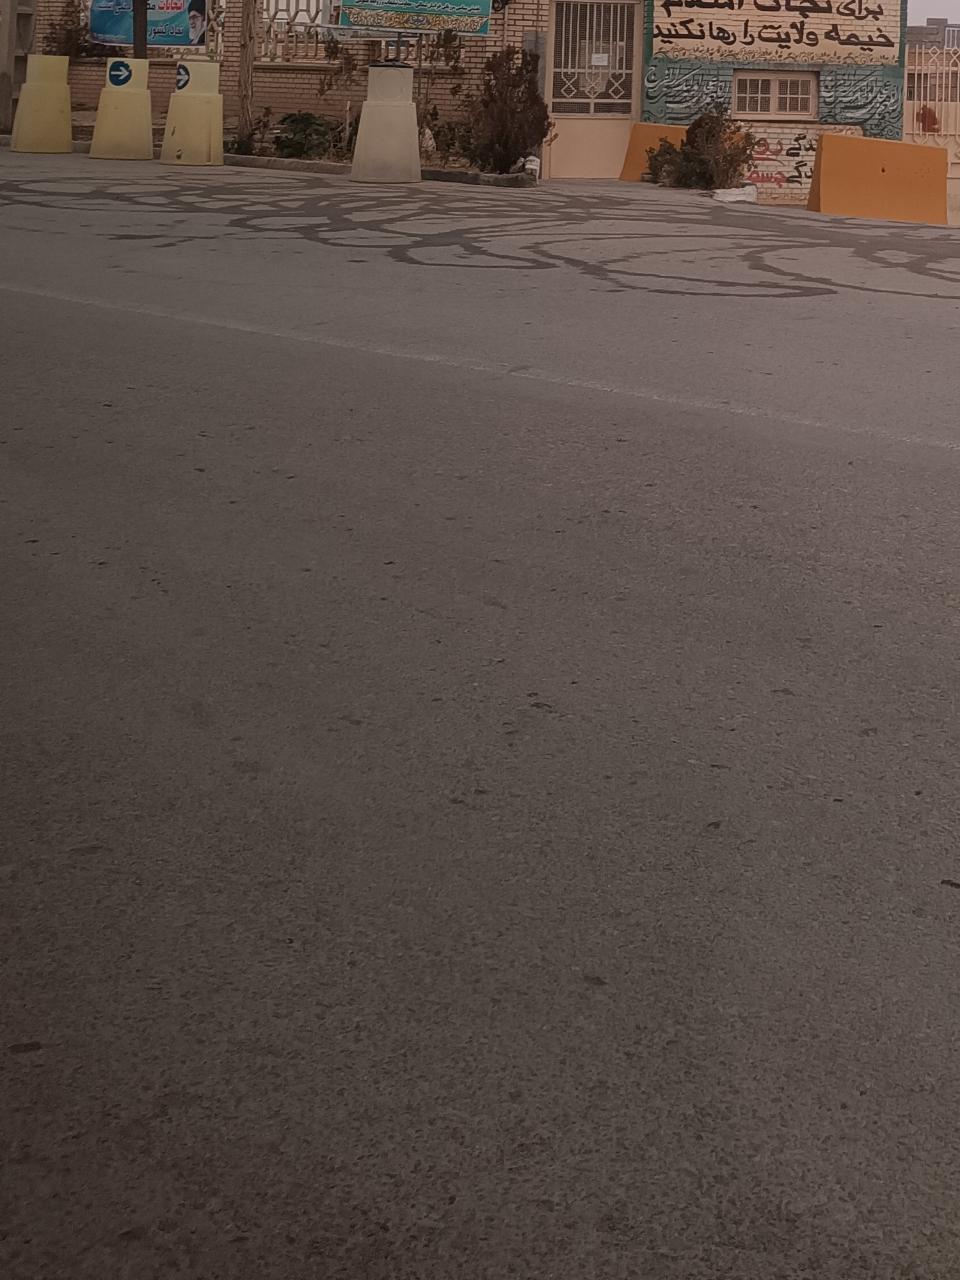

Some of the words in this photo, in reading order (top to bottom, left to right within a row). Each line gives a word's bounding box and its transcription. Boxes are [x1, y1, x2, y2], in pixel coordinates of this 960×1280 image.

[653, 18, 706, 44] نکنید
[709, 20, 738, 45] رها
[740, 18, 756, 45] را
[758, 19, 820, 49] ولایت
[823, 23, 895, 52] خیمه
